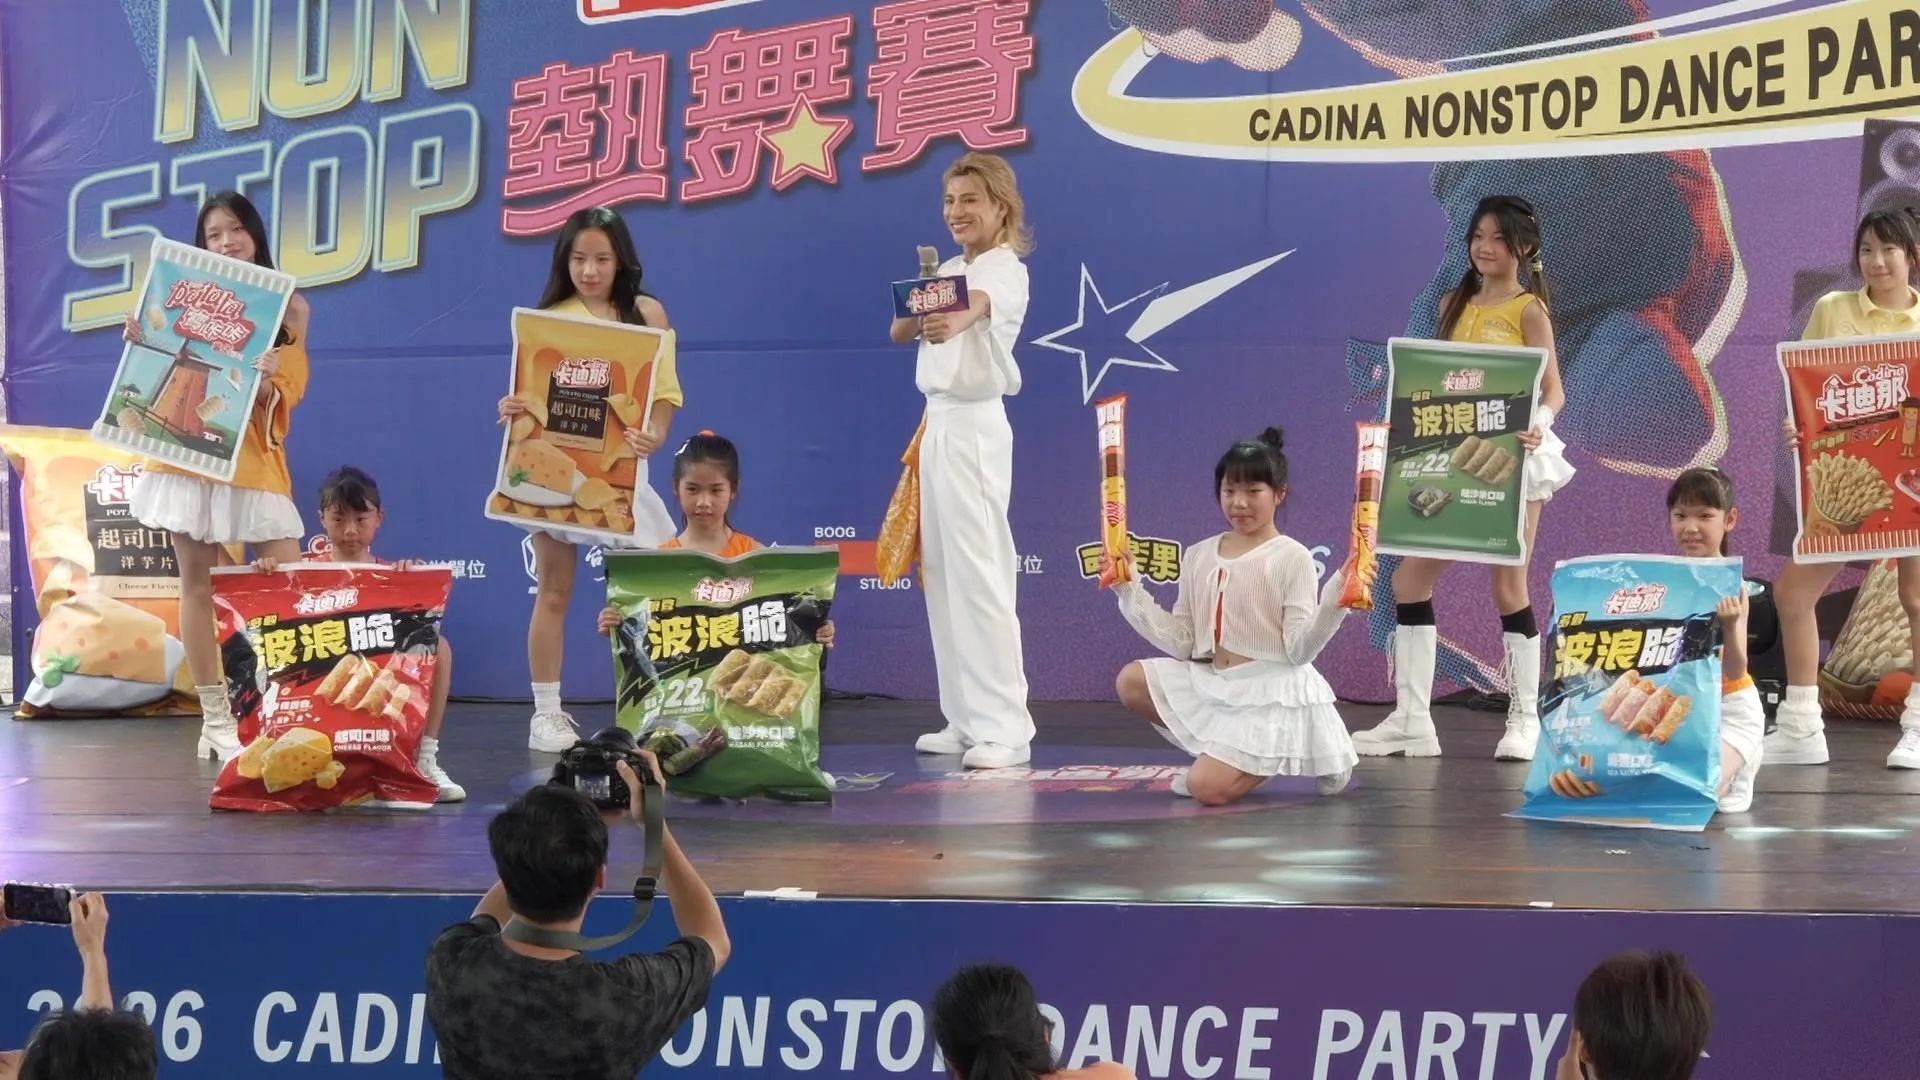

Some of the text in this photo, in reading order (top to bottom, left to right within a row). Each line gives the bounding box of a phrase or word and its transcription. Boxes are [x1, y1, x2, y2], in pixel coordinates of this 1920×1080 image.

[154, 0, 472, 142] NON
[1249, 9, 1920, 142] CADINA NONSTOP DANCE PAR
[556, 361, 608, 386] 卡迪那
[551, 401, 602, 421] 起司口味
[1818, 376, 1908, 421] 卡迪那
[1412, 400, 1507, 437] 波浪脆
[98, 527, 175, 550] 起司口
[814, 526, 856, 538] BOOG
[121, 556, 174, 570] 洋芋片
[1606, 587, 1666, 615] 卡迪那
[250, 612, 396, 670] 波浪脆
[648, 599, 788, 662] 波浪脆
[1554, 626, 1684, 680] 波浪脆
[664, 677, 704, 708] 22
[253, 991, 441, 1065] CADI
[660, 996, 946, 1073] ONSTO
[1313, 1008, 1567, 1080] PARTY
